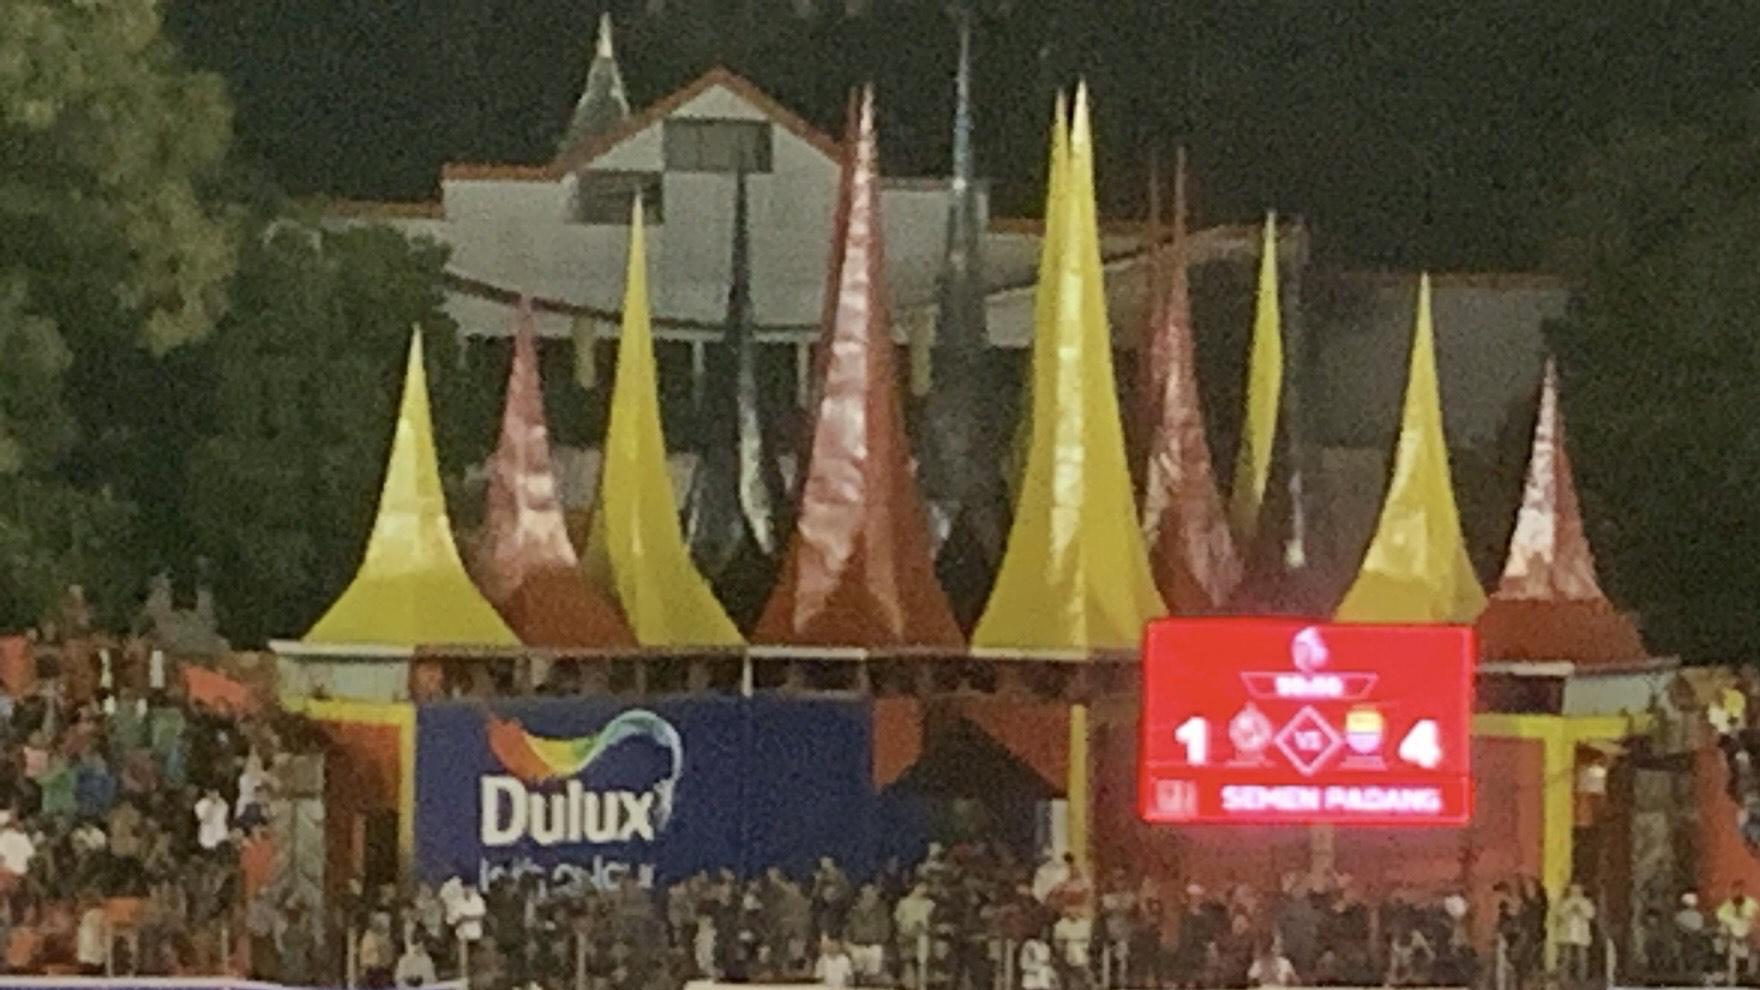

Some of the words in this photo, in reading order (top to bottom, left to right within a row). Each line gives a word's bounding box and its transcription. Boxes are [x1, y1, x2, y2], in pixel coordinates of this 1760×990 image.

[1174, 717, 1210, 766] 1
[1397, 720, 1444, 768] 4
[480, 776, 655, 846] Dulux
[1221, 785, 1321, 811] SEMEN
[1325, 786, 1442, 813] PADANG
